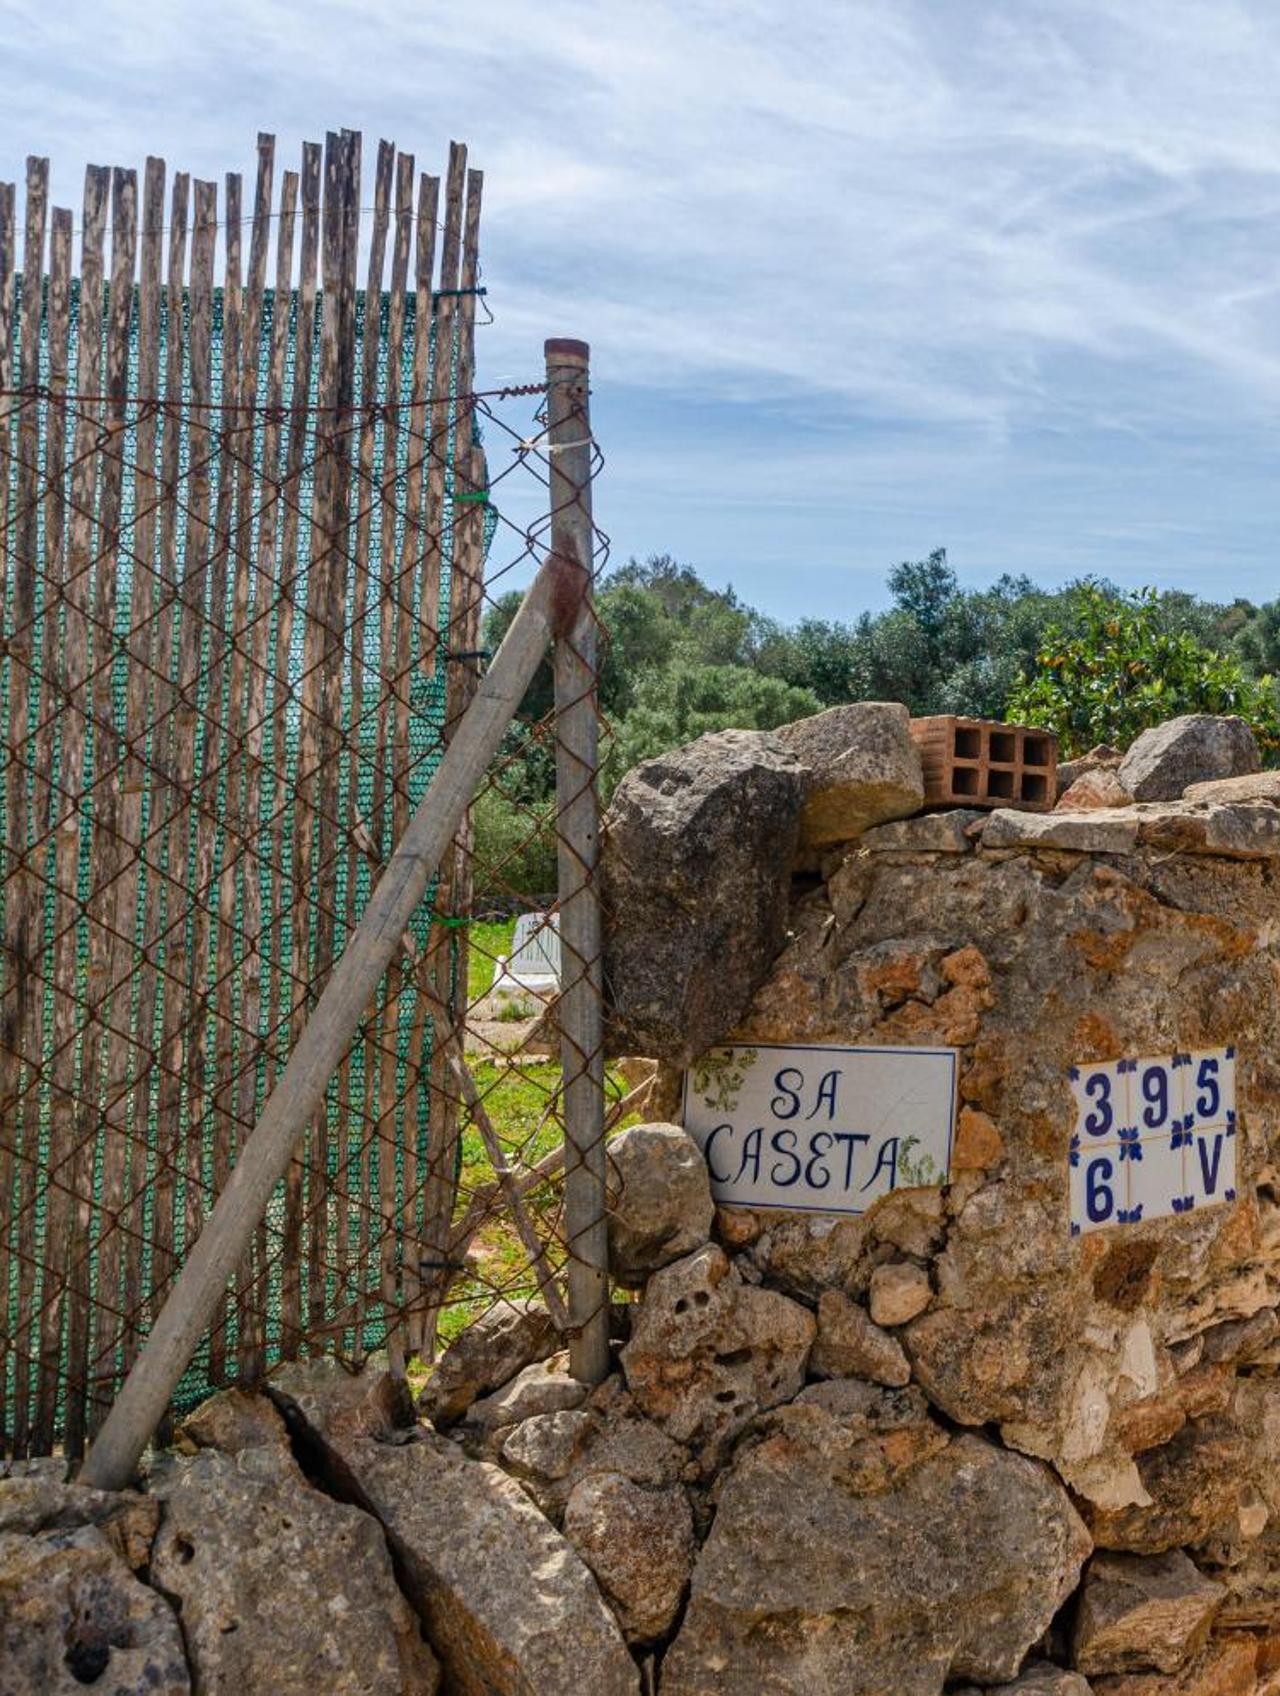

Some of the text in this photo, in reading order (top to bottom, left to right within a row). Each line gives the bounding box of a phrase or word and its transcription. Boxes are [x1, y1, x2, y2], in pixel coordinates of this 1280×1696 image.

[771, 1067, 843, 1120] SA
[1085, 1059, 1220, 1137] 395
[704, 1123, 901, 1192] CASETA
[1086, 1134, 1223, 1223] 6 V
